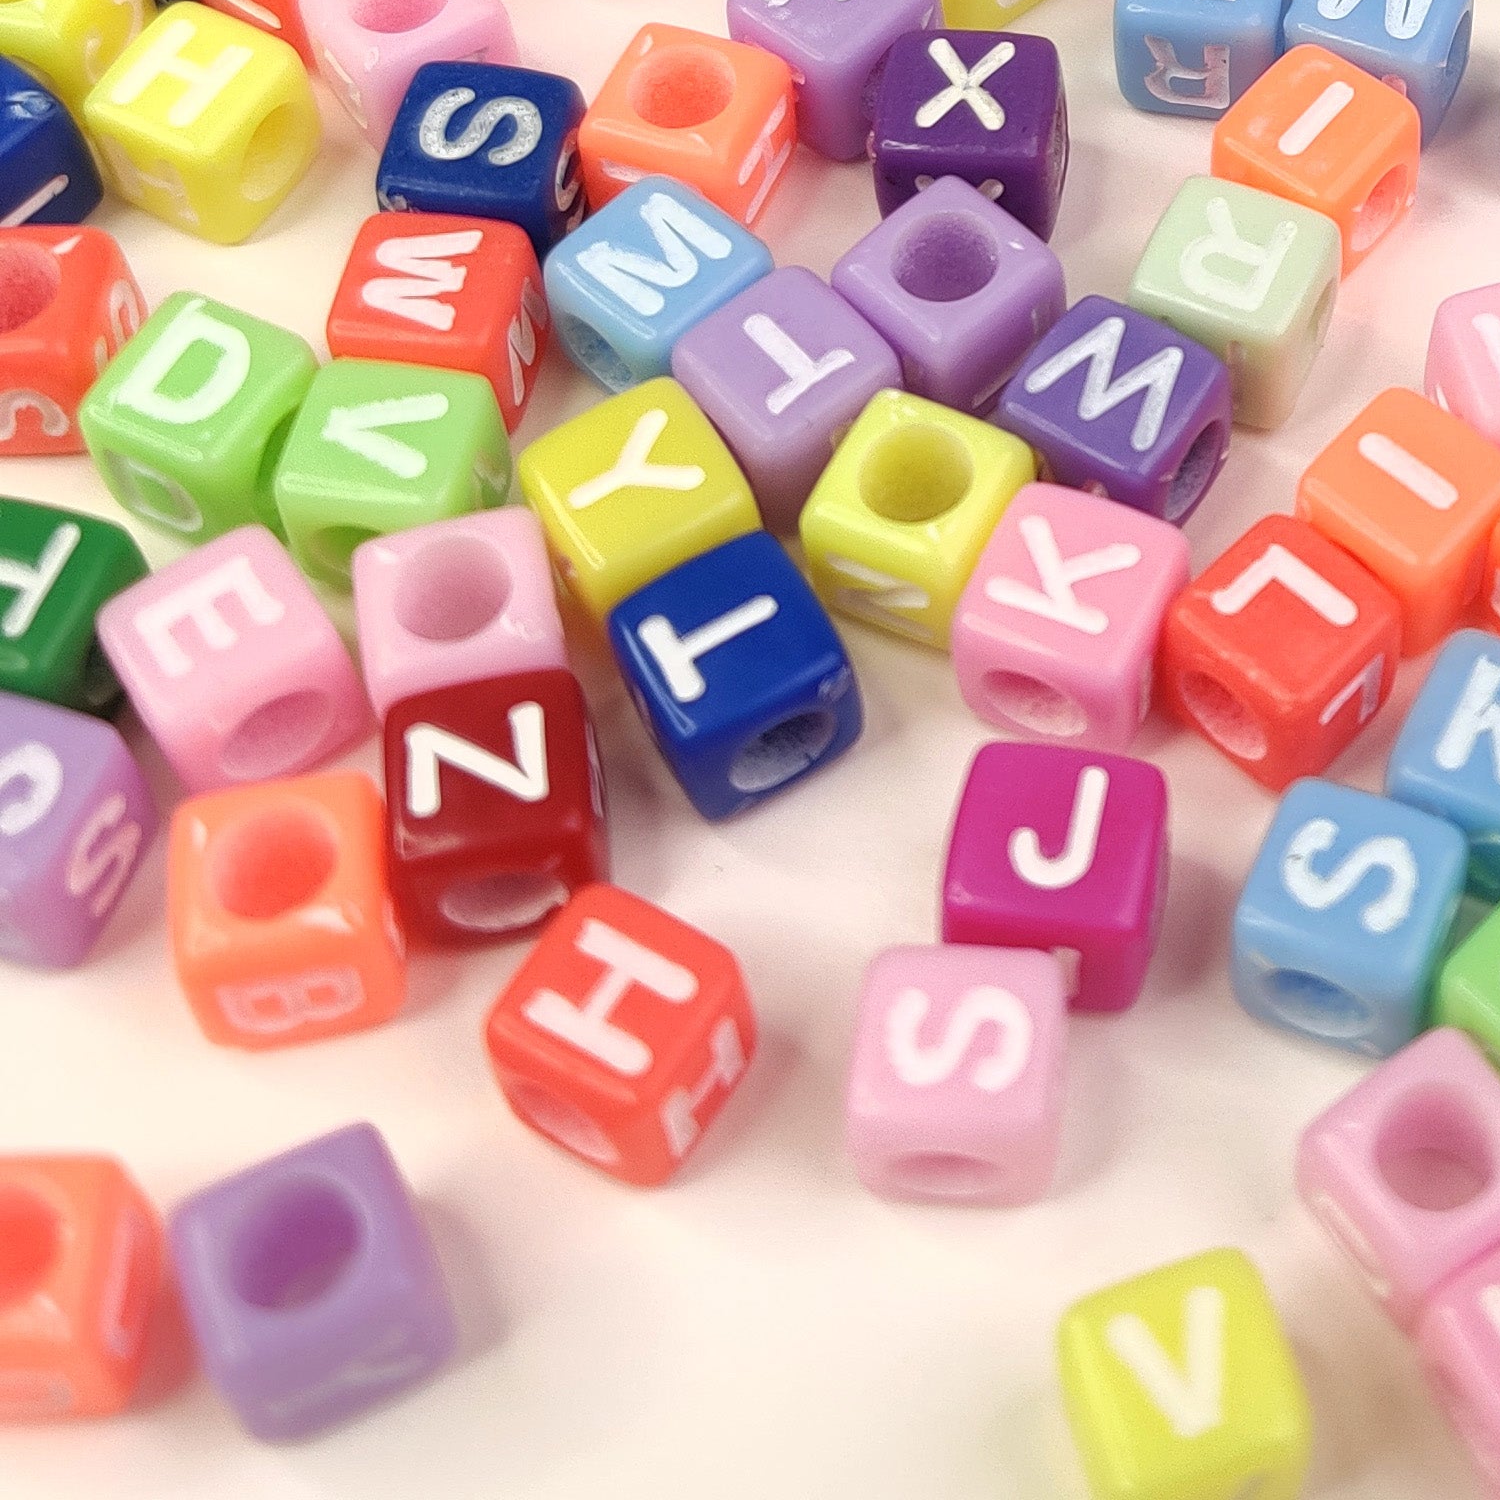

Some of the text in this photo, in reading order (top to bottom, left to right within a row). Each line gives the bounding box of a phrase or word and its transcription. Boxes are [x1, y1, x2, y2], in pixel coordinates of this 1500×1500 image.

[107, 18, 254, 128] H
[418, 87, 543, 165] S
[915, 37, 1016, 132] X
[1143, 35, 1231, 110] R
[1277, 80, 1355, 156] I
[360, 229, 485, 332] W
[575, 191, 732, 316] M
[1178, 196, 1297, 312] R
[106, 299, 251, 425] D
[742, 312, 856, 415] T
[320, 392, 449, 479] V
[568, 408, 707, 510] Y
[1357, 432, 1459, 511] I
[134, 553, 286, 678] E
[985, 514, 1142, 635] K
[1208, 541, 1359, 627] L
[637, 594, 779, 703] T
[66, 791, 143, 919] S
[1008, 765, 1110, 889] J
[1280, 817, 1419, 935] S
[214, 966, 368, 1036] B
[520, 917, 699, 1078] H
[886, 985, 1034, 1093] S
[660, 1016, 748, 1160] H
[1106, 1284, 1225, 1439] V
